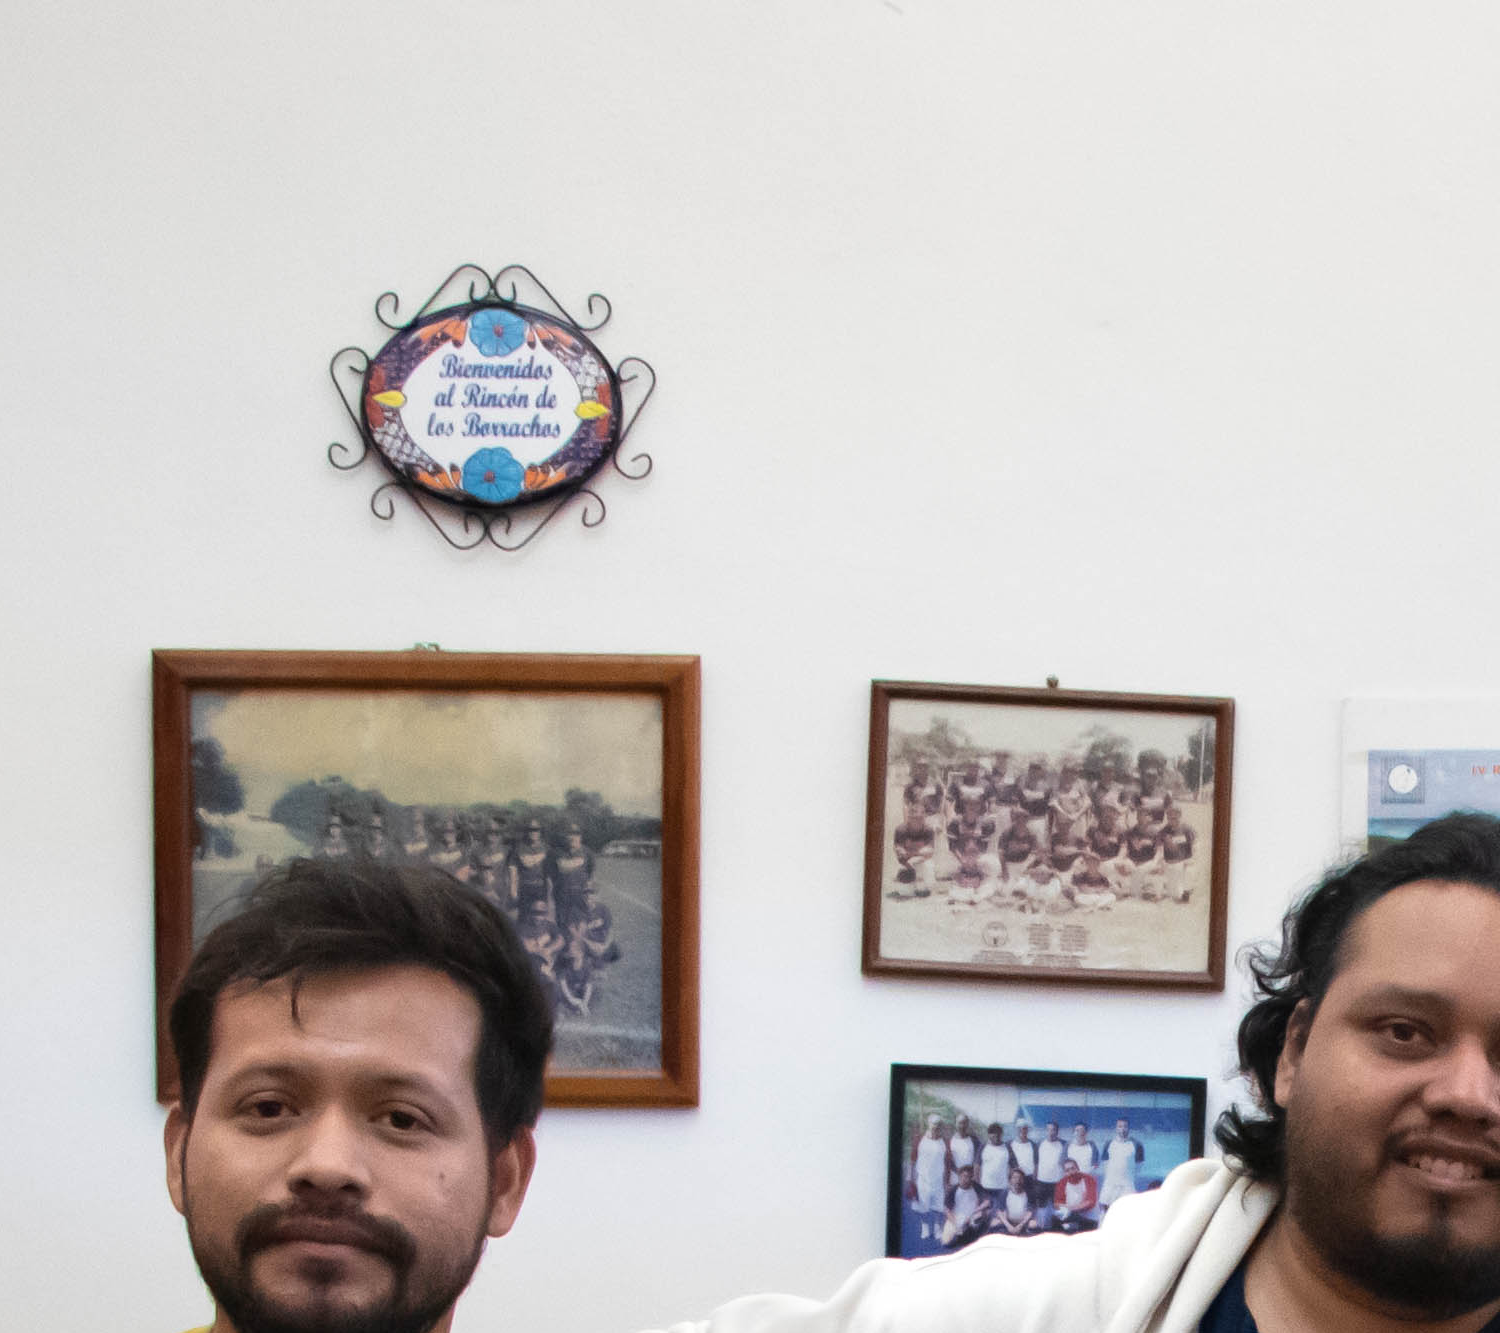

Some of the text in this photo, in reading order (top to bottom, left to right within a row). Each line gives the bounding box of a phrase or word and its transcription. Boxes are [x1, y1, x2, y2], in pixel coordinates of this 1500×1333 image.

[439, 354, 553, 379] Bienvenidos
[435, 384, 557, 409] al Rincón de
[428, 413, 560, 438] los Borrachos
[1471, 764, 1486, 777] IV
